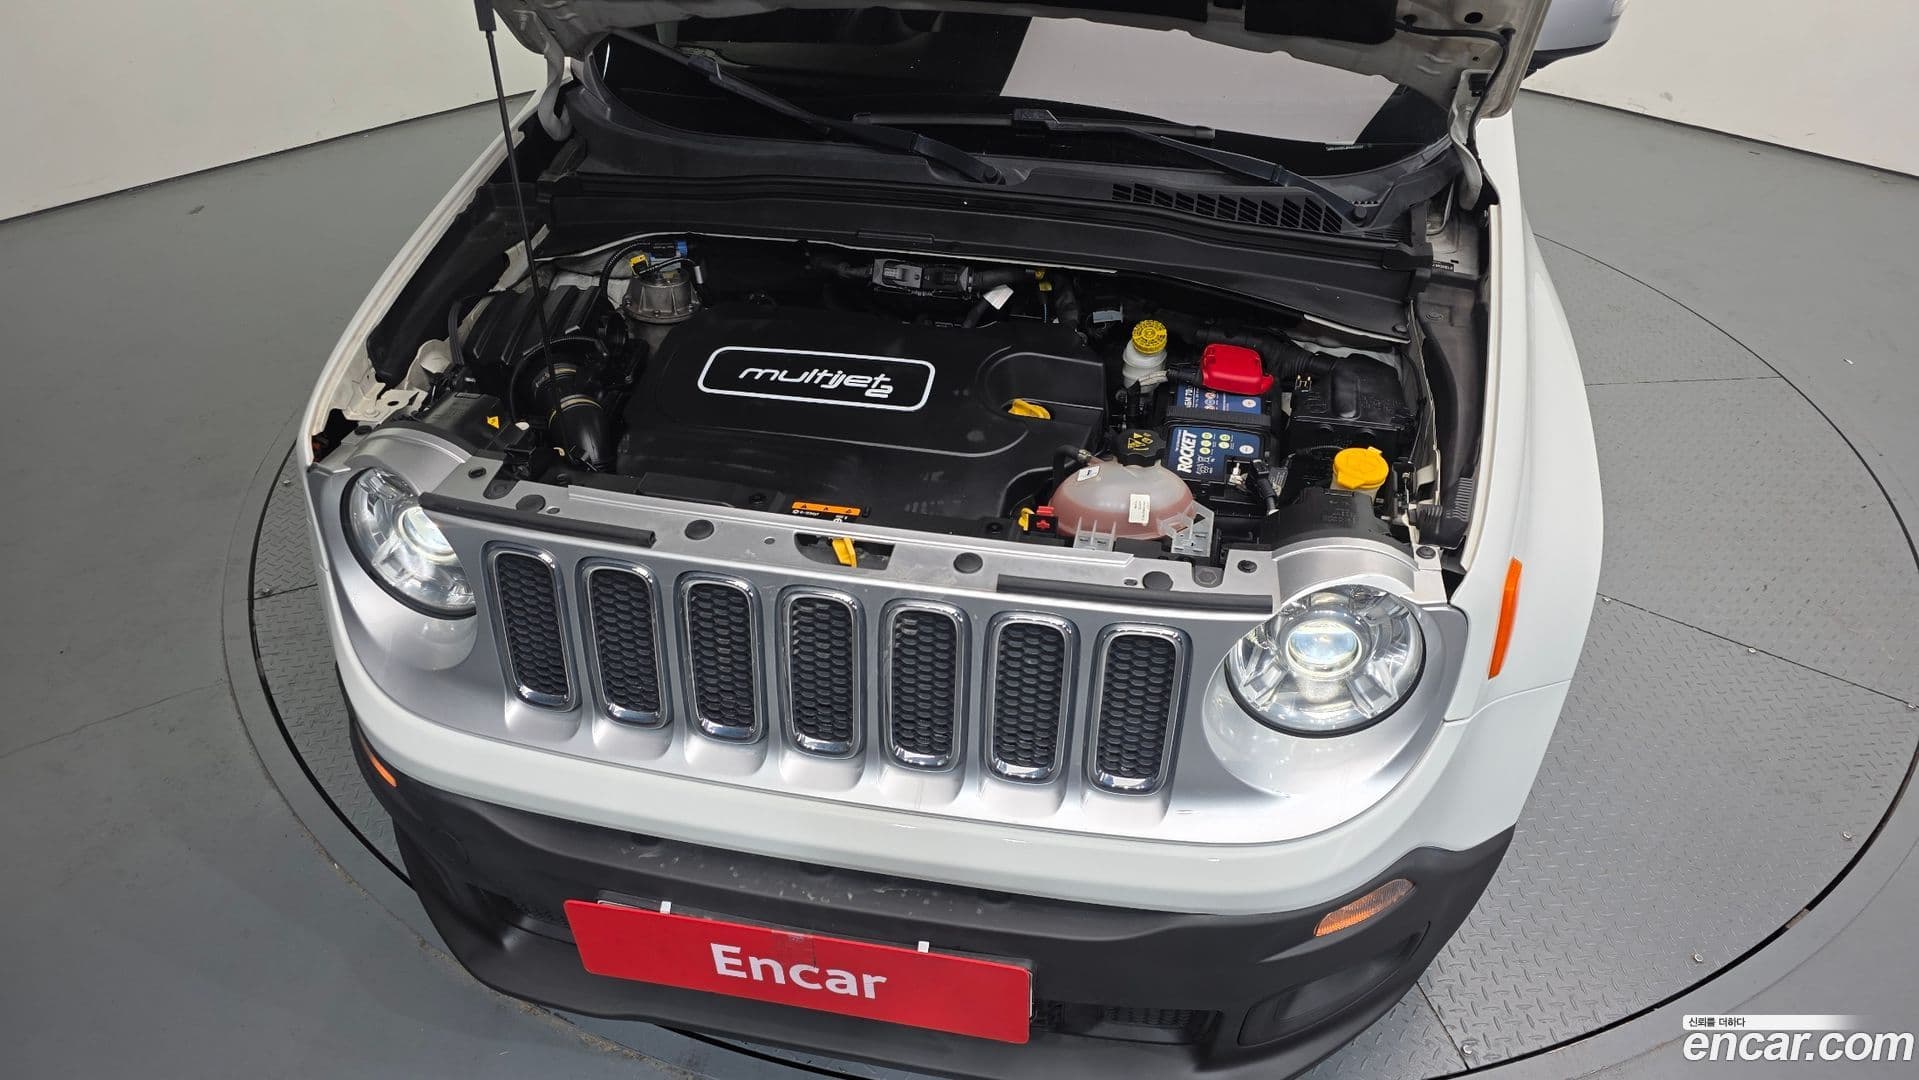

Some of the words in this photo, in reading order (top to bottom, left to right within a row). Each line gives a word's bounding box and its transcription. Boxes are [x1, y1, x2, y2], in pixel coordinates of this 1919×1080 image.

[738, 367, 891, 389] multijet
[1177, 430, 1198, 474] ROCKET
[710, 942, 887, 1000] Encar
